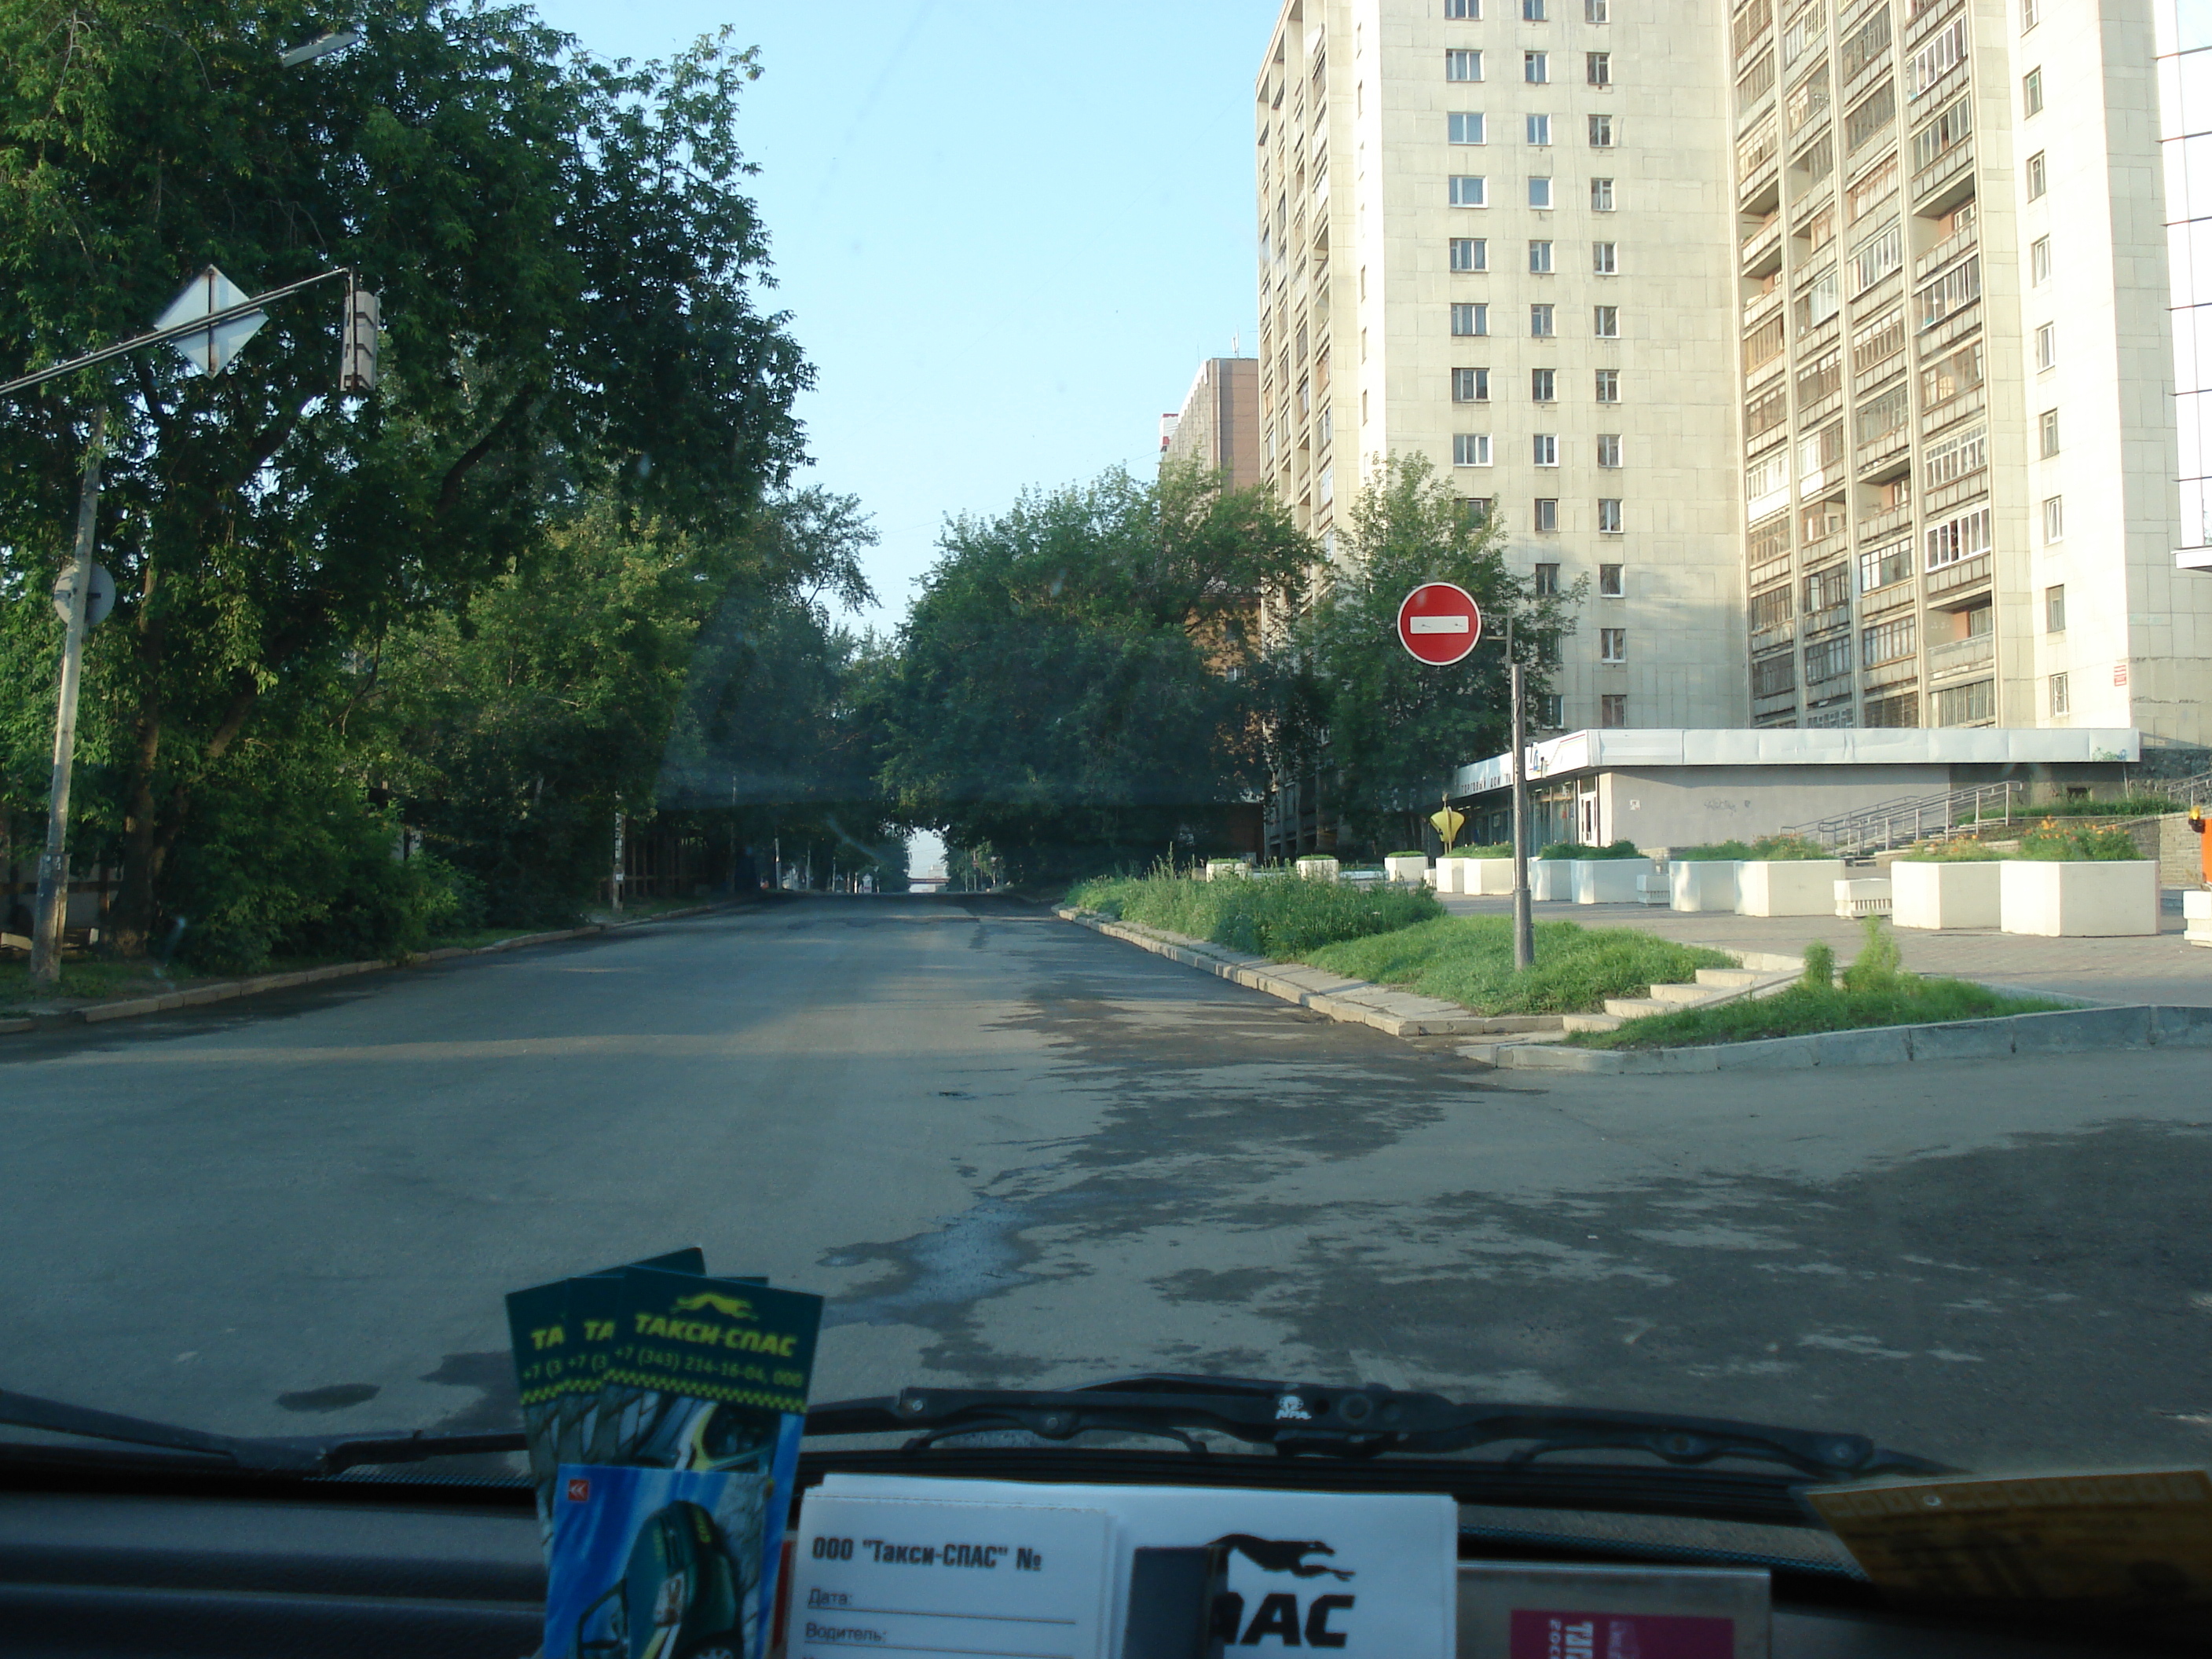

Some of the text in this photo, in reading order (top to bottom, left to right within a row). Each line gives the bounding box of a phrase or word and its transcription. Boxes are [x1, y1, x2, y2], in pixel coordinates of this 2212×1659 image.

[1461, 777, 1486, 794] ТОРГОВЫЙ
[812, 1536, 855, 1560] ООО
[862, 1540, 1009, 1569] "Такси-СПАС"
[808, 1588, 853, 1607] Дата:
[805, 1621, 888, 1643] Водитель:
